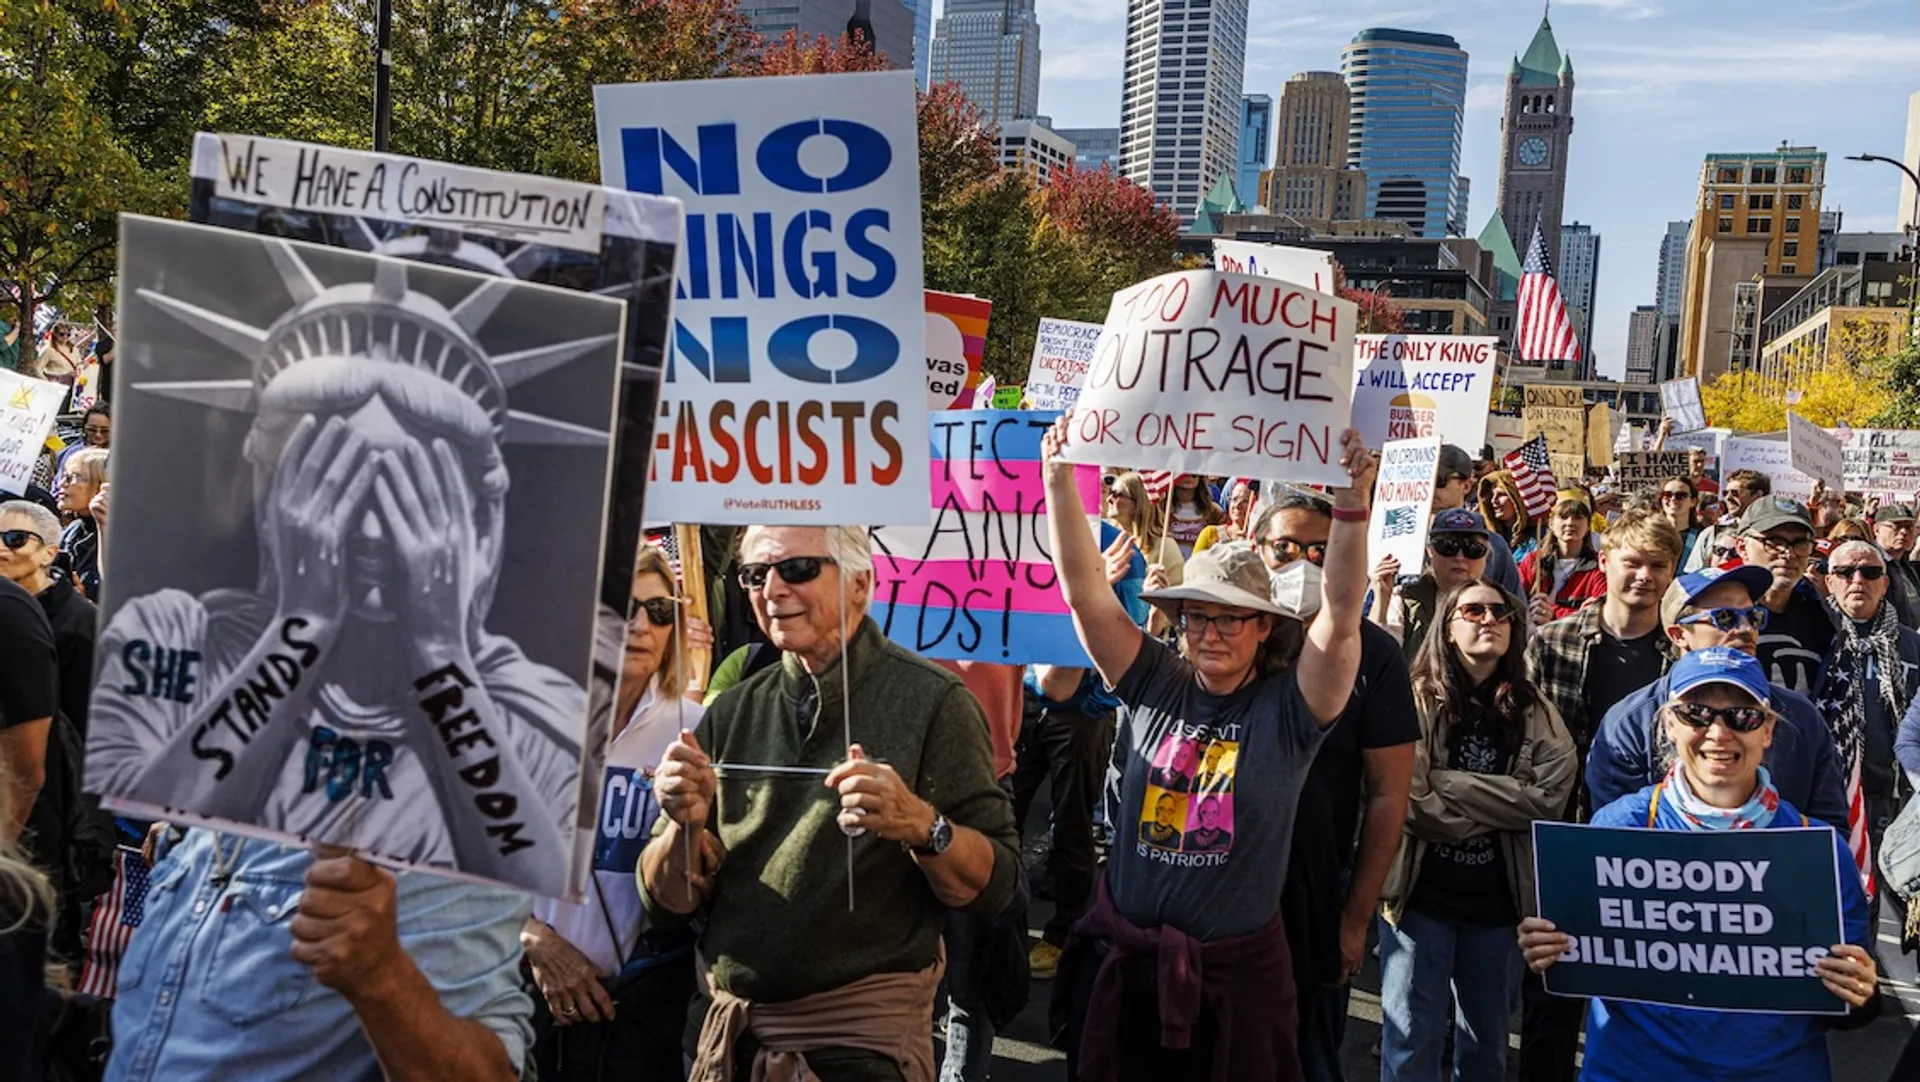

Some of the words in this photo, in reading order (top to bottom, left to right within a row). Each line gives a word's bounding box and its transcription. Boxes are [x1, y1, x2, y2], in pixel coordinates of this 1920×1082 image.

[620, 118, 892, 196] NO
[221, 138, 269, 197] WE
[292, 149, 357, 208] HAVE
[363, 162, 386, 212] A
[398, 162, 594, 229] CONSTITUTION
[676, 208, 897, 299] INGS
[1124, 278, 1190, 325] TOO
[1210, 279, 1337, 342] MUCH
[1040, 321, 1103, 340] DEMOCRACY
[665, 314, 900, 385] NO
[1090, 327, 1333, 403] OUTRAGE
[1358, 340, 1388, 360] THE
[1393, 341, 1437, 361] ONLY
[1440, 343, 1489, 364] KING
[1357, 370, 1365, 386] I
[1370, 370, 1409, 389] WILL
[1411, 371, 1476, 392] ACCEPT
[1526, 388, 1557, 405] ONLY
[1559, 388, 1584, 405] YOU
[1388, 421, 1433, 438] KING
[1389, 408, 1436, 423] BURGER
[1526, 408, 1543, 420] CAN
[1135, 411, 1216, 451] ONE
[1231, 414, 1331, 465] SIGN
[1398, 446, 1437, 464] CROWNS
[1620, 465, 1690, 478] FRIENDS
[1626, 453, 1638, 464] I
[1646, 452, 1690, 465] HAVE
[722, 497, 822, 512] @VoteRUTHLESS
[1378, 482, 1395, 502] NO
[1395, 480, 1431, 502] KINGS
[876, 580, 1012, 658] IDS!
[121, 639, 203, 704] SHE
[190, 616, 321, 782] STANDS
[303, 726, 394, 803] FOR
[413, 661, 536, 858] FREEDOM
[1136, 842, 1148, 858] IS
[1150, 848, 1230, 868] PATRIOTIC
[1595, 855, 1771, 893] NOBODY
[1599, 898, 1774, 935] ELECTED
[1559, 933, 1832, 979] BILLIONAIRES
